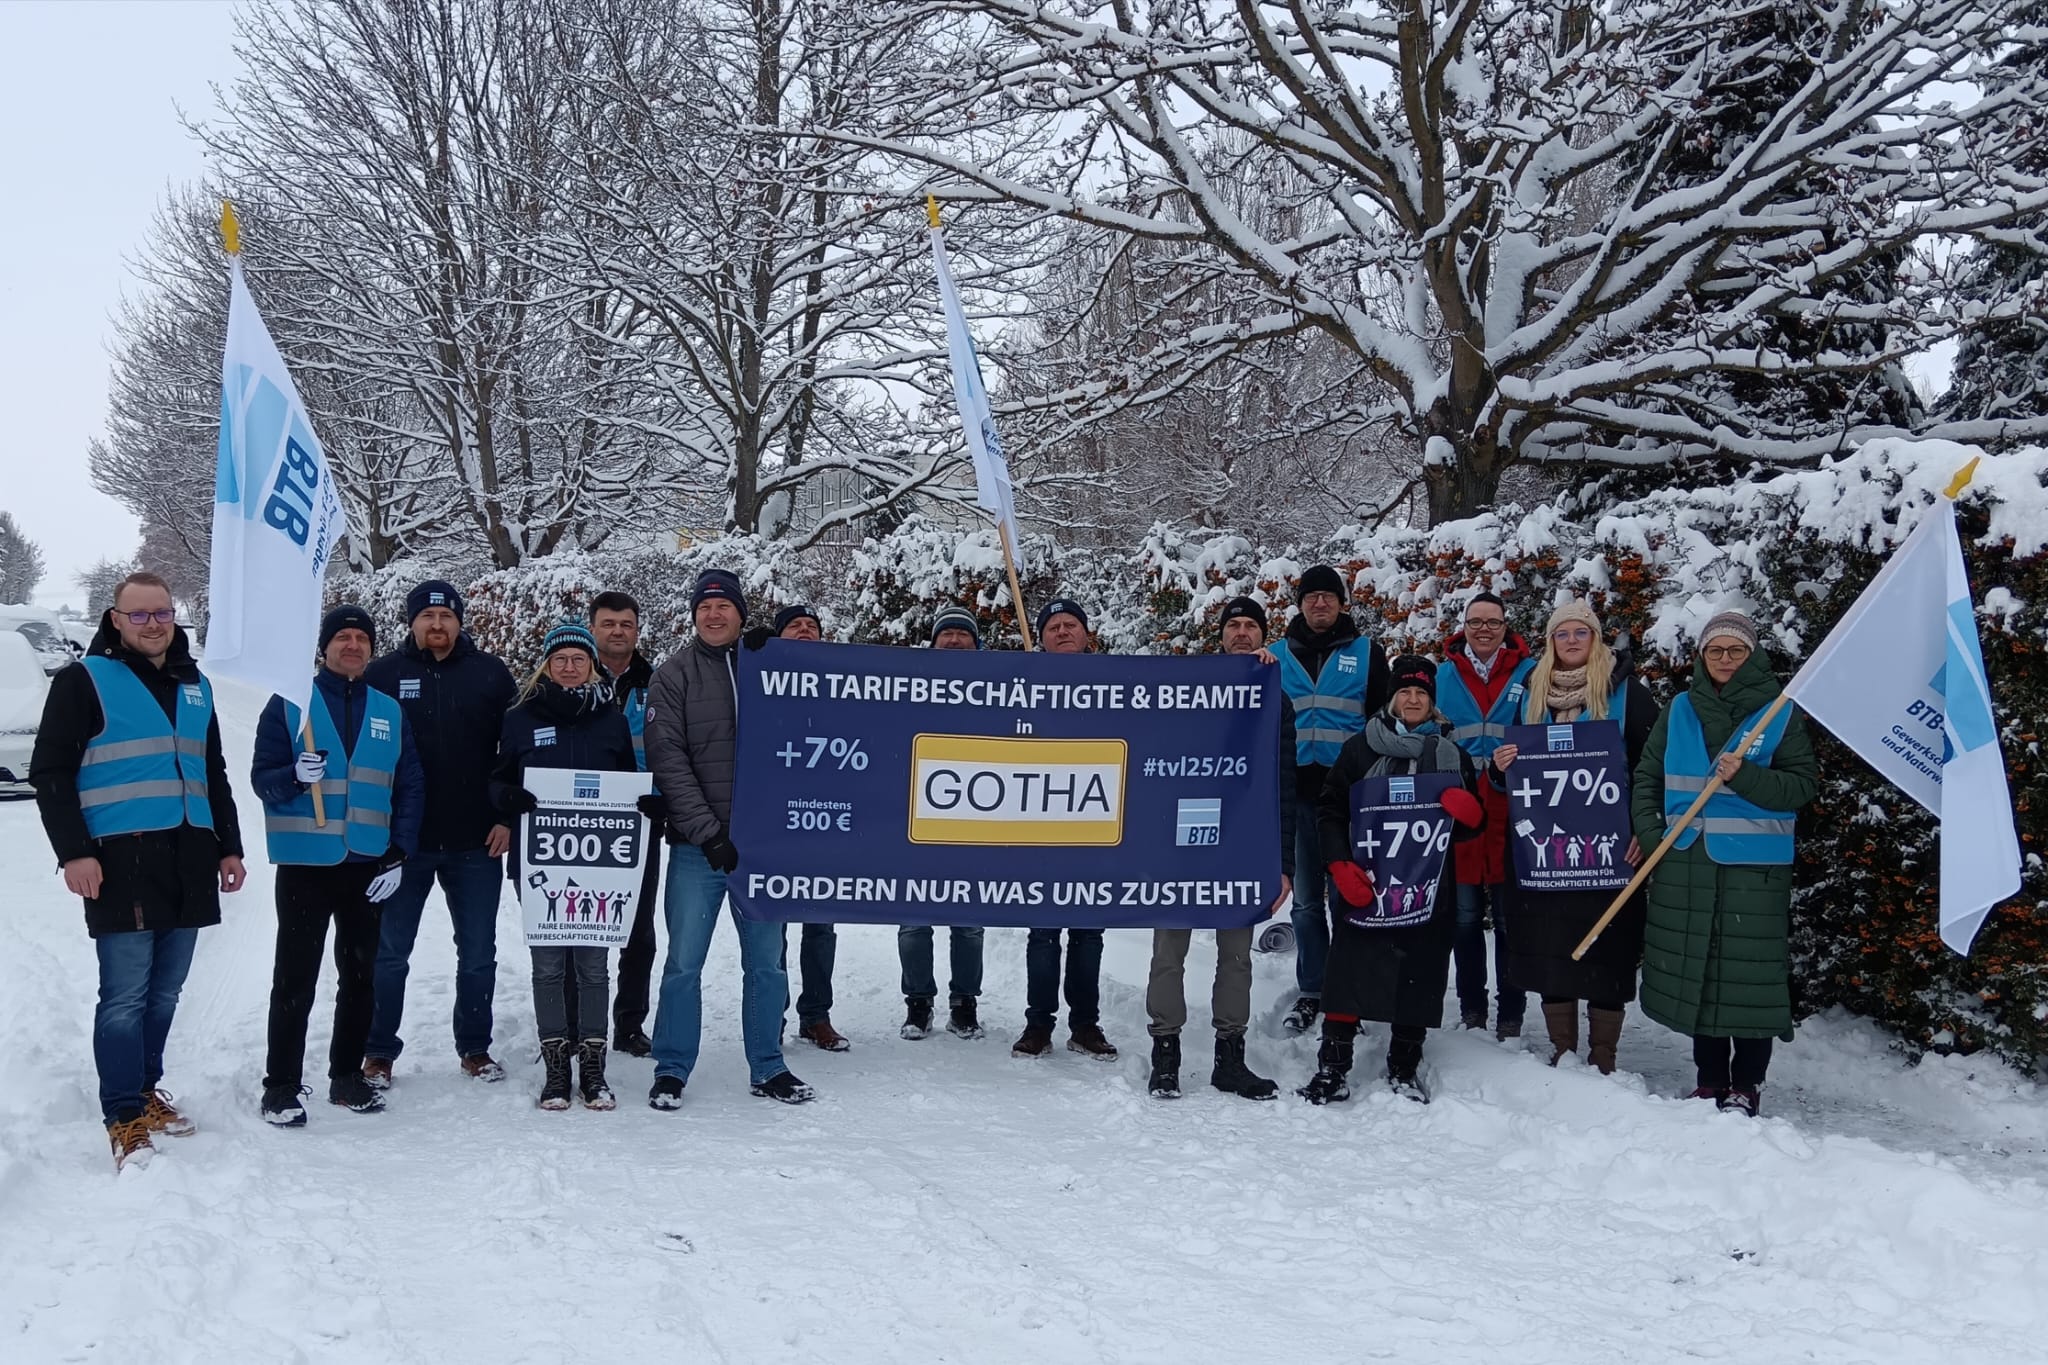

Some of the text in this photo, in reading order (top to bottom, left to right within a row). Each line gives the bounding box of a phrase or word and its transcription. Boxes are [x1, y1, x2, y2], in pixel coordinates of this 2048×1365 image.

[761, 670, 1262, 709] WIR TARIFBESCHÄFTIGTE & BEAMTE
[1016, 718, 1033, 734] in
[776, 736, 869, 771] +7%
[1554, 740, 1573, 751] BTB
[1881, 735, 1906, 754] und
[1891, 725, 1944, 768] Gewerksch
[1143, 756, 1248, 778] #tvl25/26
[579, 788, 600, 799] BTB
[925, 769, 1110, 812] GOTHA
[1395, 791, 1414, 802] BTB
[1512, 767, 1620, 808] +7%
[787, 798, 852, 811] mindestens
[535, 813, 635, 830] mindestens
[786, 811, 851, 832] 300 €
[1188, 826, 1219, 845] BTB
[1357, 819, 1450, 859] +7%
[535, 832, 632, 863] 300 €
[1530, 868, 1615, 878] FAIRE EINKOMMEN FÜR
[748, 874, 1261, 906] FORDERN NUR WAS UNS ZUSTEHT!
[1520, 878, 1591, 888] TARIFBESCHÄFTIGTE
[538, 922, 621, 932] FAIRE EINKOMMEN FÜR
[527, 932, 598, 941] TARIFBESCHÄFTIGTE
[605, 935, 628, 943] BEAMT
